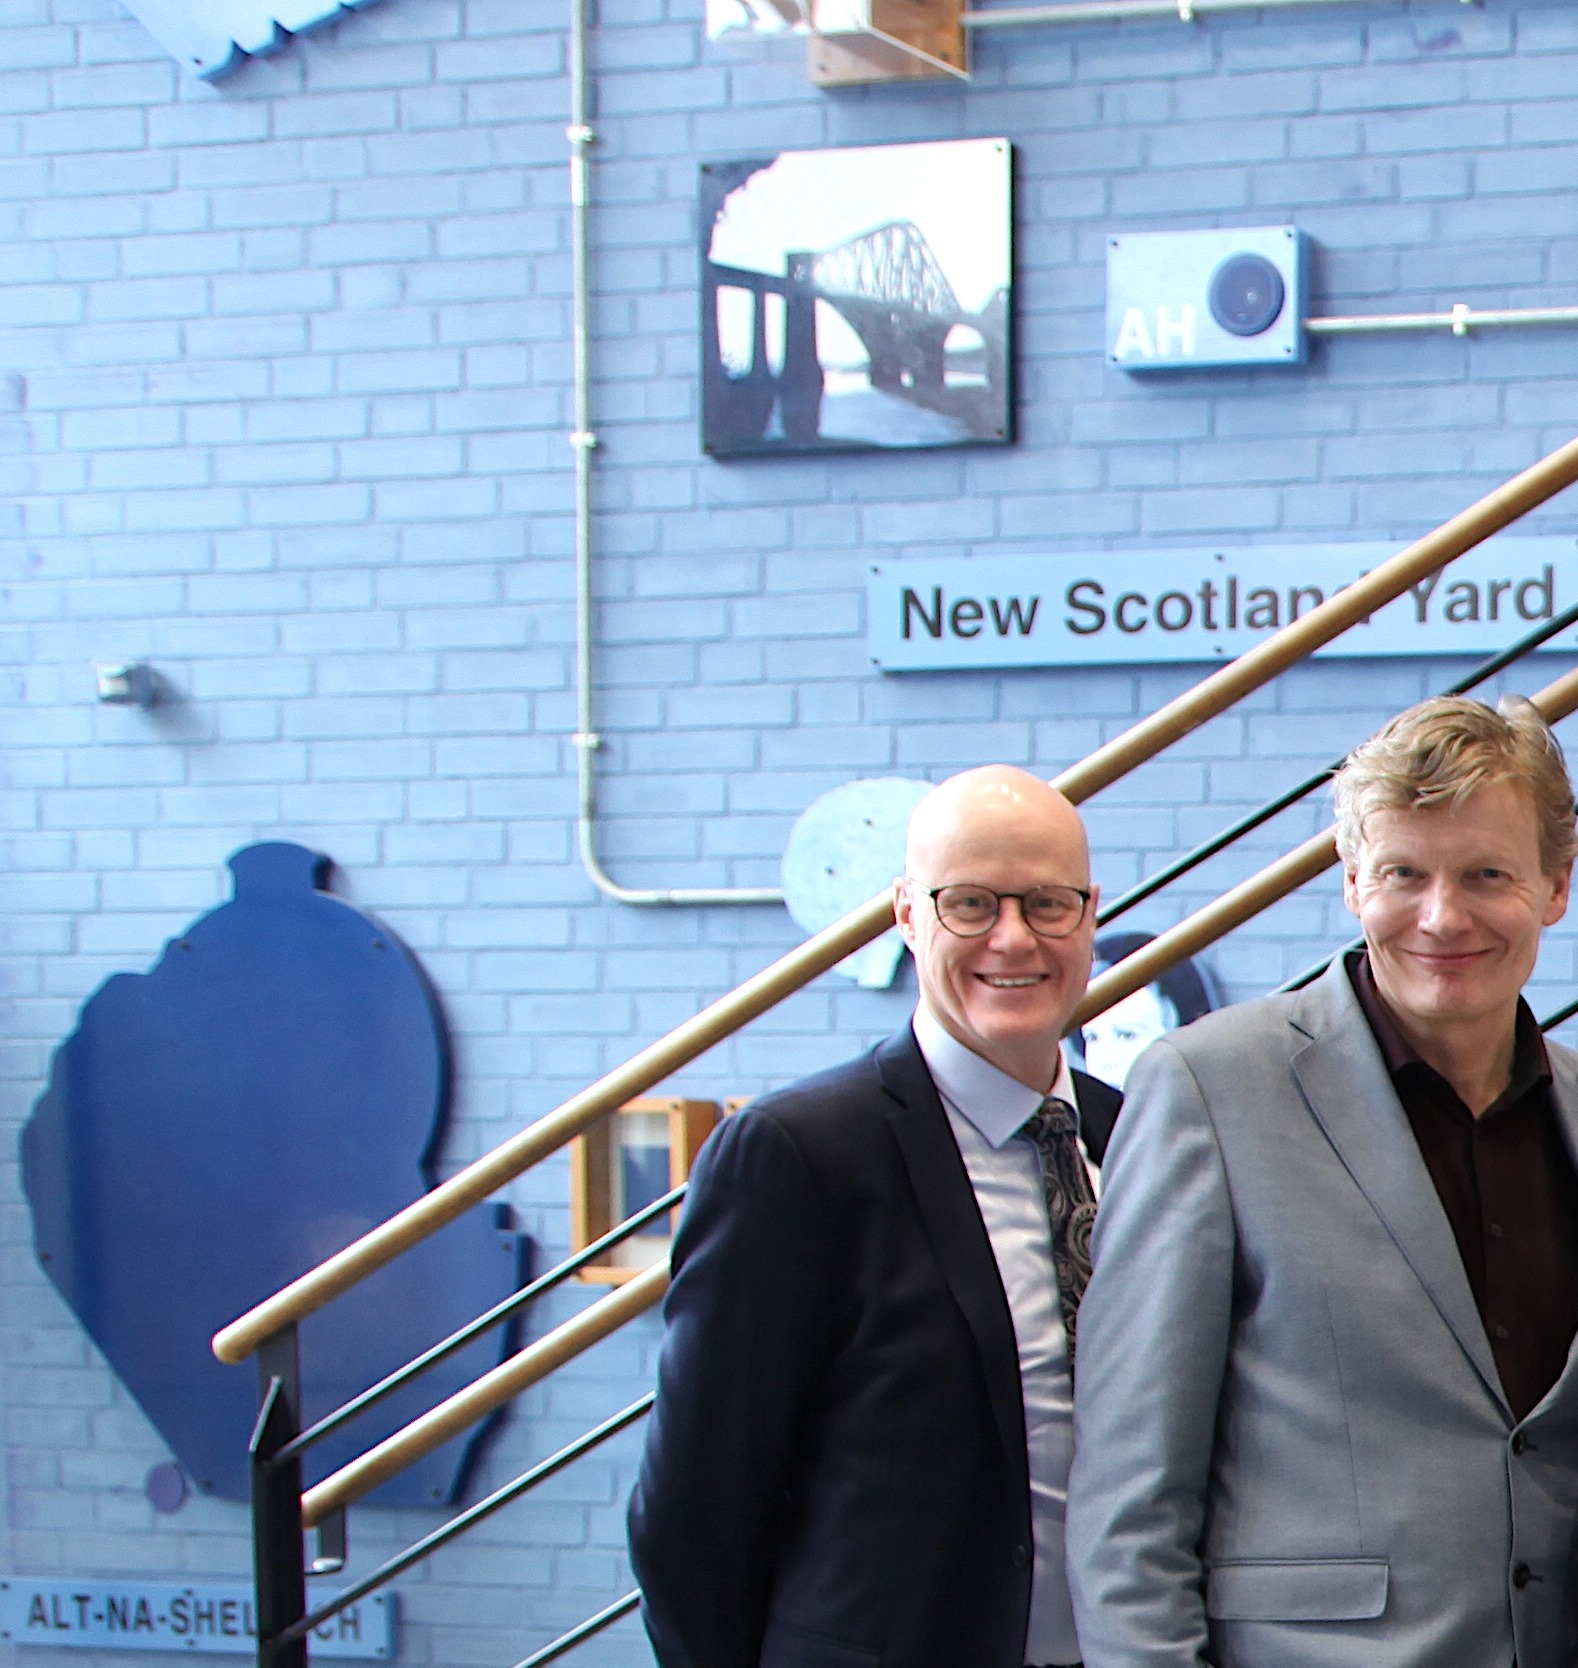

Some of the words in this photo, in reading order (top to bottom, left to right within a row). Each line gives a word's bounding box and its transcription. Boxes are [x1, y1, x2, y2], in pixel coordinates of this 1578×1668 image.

[1114, 303, 1196, 358] AH
[900, 581, 1039, 641] New
[1064, 568, 1371, 636] Scotlan
[1404, 564, 1555, 624] Yard
